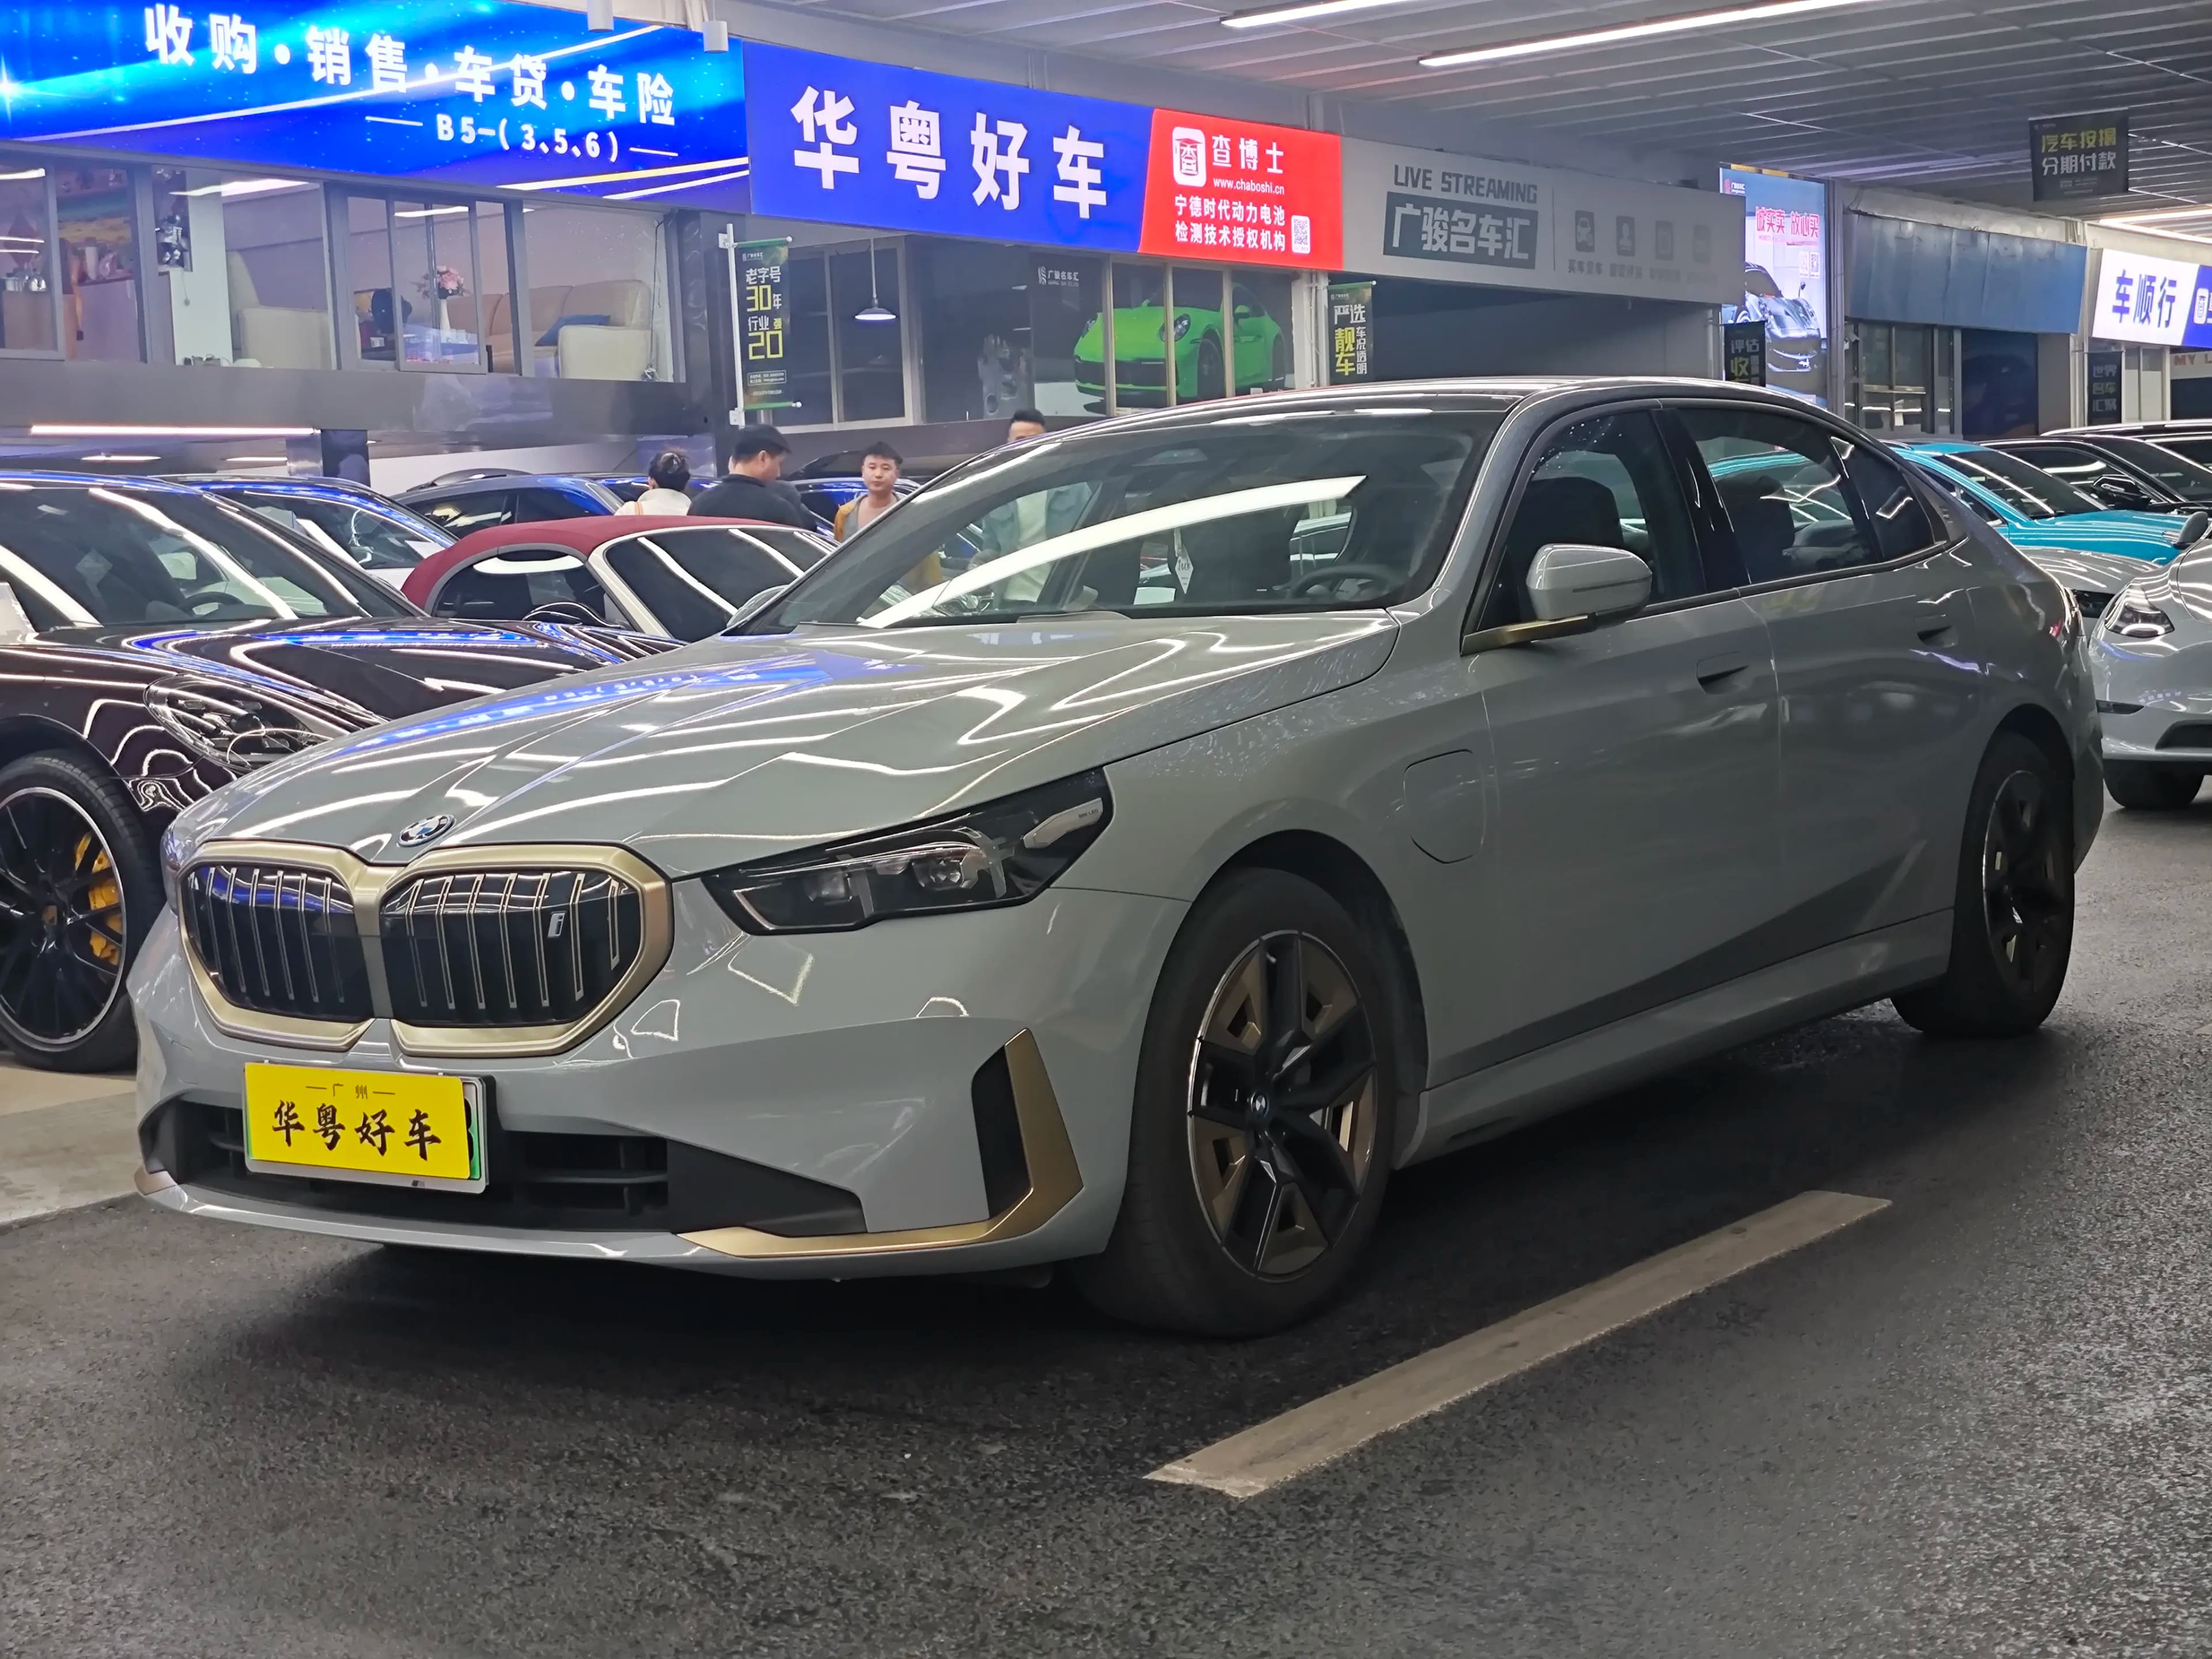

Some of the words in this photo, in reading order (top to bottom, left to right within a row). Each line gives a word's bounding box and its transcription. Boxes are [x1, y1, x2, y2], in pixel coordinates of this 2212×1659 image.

[790, 85, 1107, 219] 华粤好车
[1211, 135, 1284, 174] 查博士
[2041, 151, 2116, 176] 分期付款
[1213, 177, 1285, 195] www.chaboshi.cn
[1394, 164, 1433, 191] LIVE
[1441, 171, 1537, 204] STREAMING
[1175, 194, 1286, 226] 宁德时代动力电池
[1175, 220, 1286, 252] 检测技术授权机构
[1392, 203, 1530, 260] 广骏名车汇
[746, 266, 781, 285] 老字号
[1334, 303, 1366, 325] 严选
[2112, 268, 2177, 328] 车顺行
[748, 315, 769, 331] 行业
[748, 330, 783, 360] 20
[1335, 327, 1355, 376] 靓车
[1356, 326, 1368, 374] 车况透明
[1730, 357, 1749, 381] 收
[332, 1083, 368, 1099] 广州
[272, 1099, 441, 1161] 华粤好车
